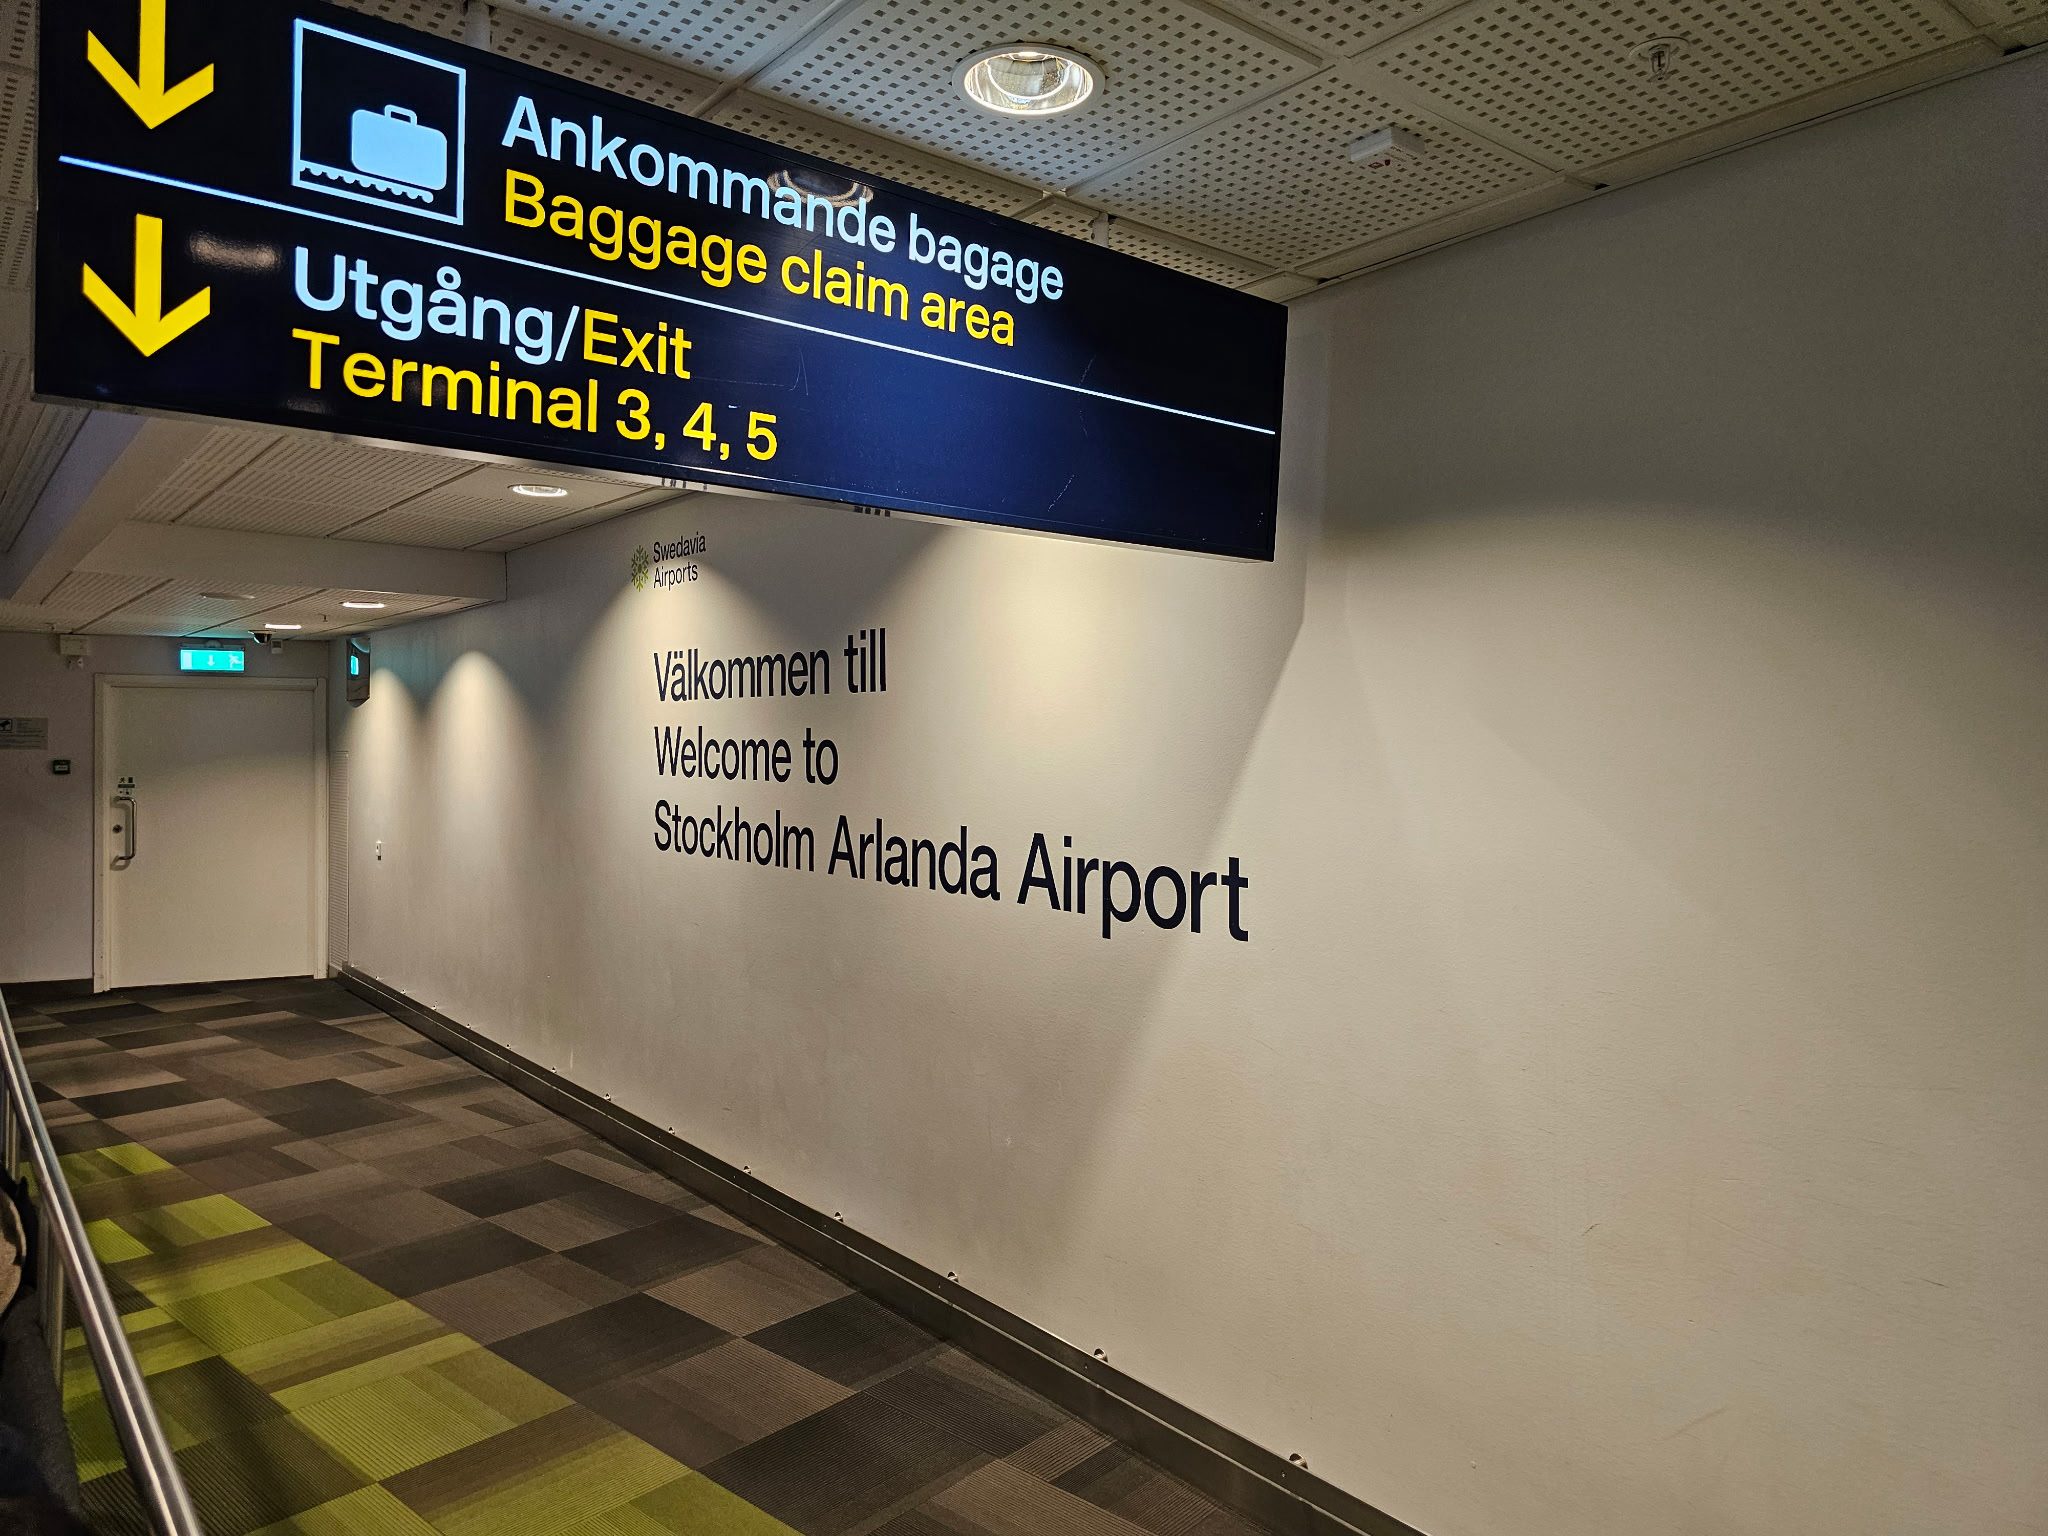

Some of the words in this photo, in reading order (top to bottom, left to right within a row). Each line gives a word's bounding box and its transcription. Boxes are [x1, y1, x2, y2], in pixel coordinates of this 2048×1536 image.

[502, 95, 897, 254] Ankommande
[908, 212, 1065, 304] bagage
[503, 168, 768, 289] Baggage
[780, 248, 910, 322] claim
[921, 292, 1015, 347] area
[293, 245, 692, 381] Utgång/Exit
[291, 327, 599, 434] Terminal
[614, 387, 666, 451] 3,
[683, 402, 731, 460] 4,
[746, 411, 778, 462] 5
[653, 531, 706, 563] Swedavia
[653, 562, 698, 591] Airports
[653, 648, 830, 702] Välkommen
[843, 627, 887, 694] till
[654, 726, 792, 783] Welcome
[802, 727, 839, 786] to
[653, 799, 815, 872] Stockholm
[827, 814, 1001, 902] Arlanda
[1016, 832, 1250, 943] Airport
